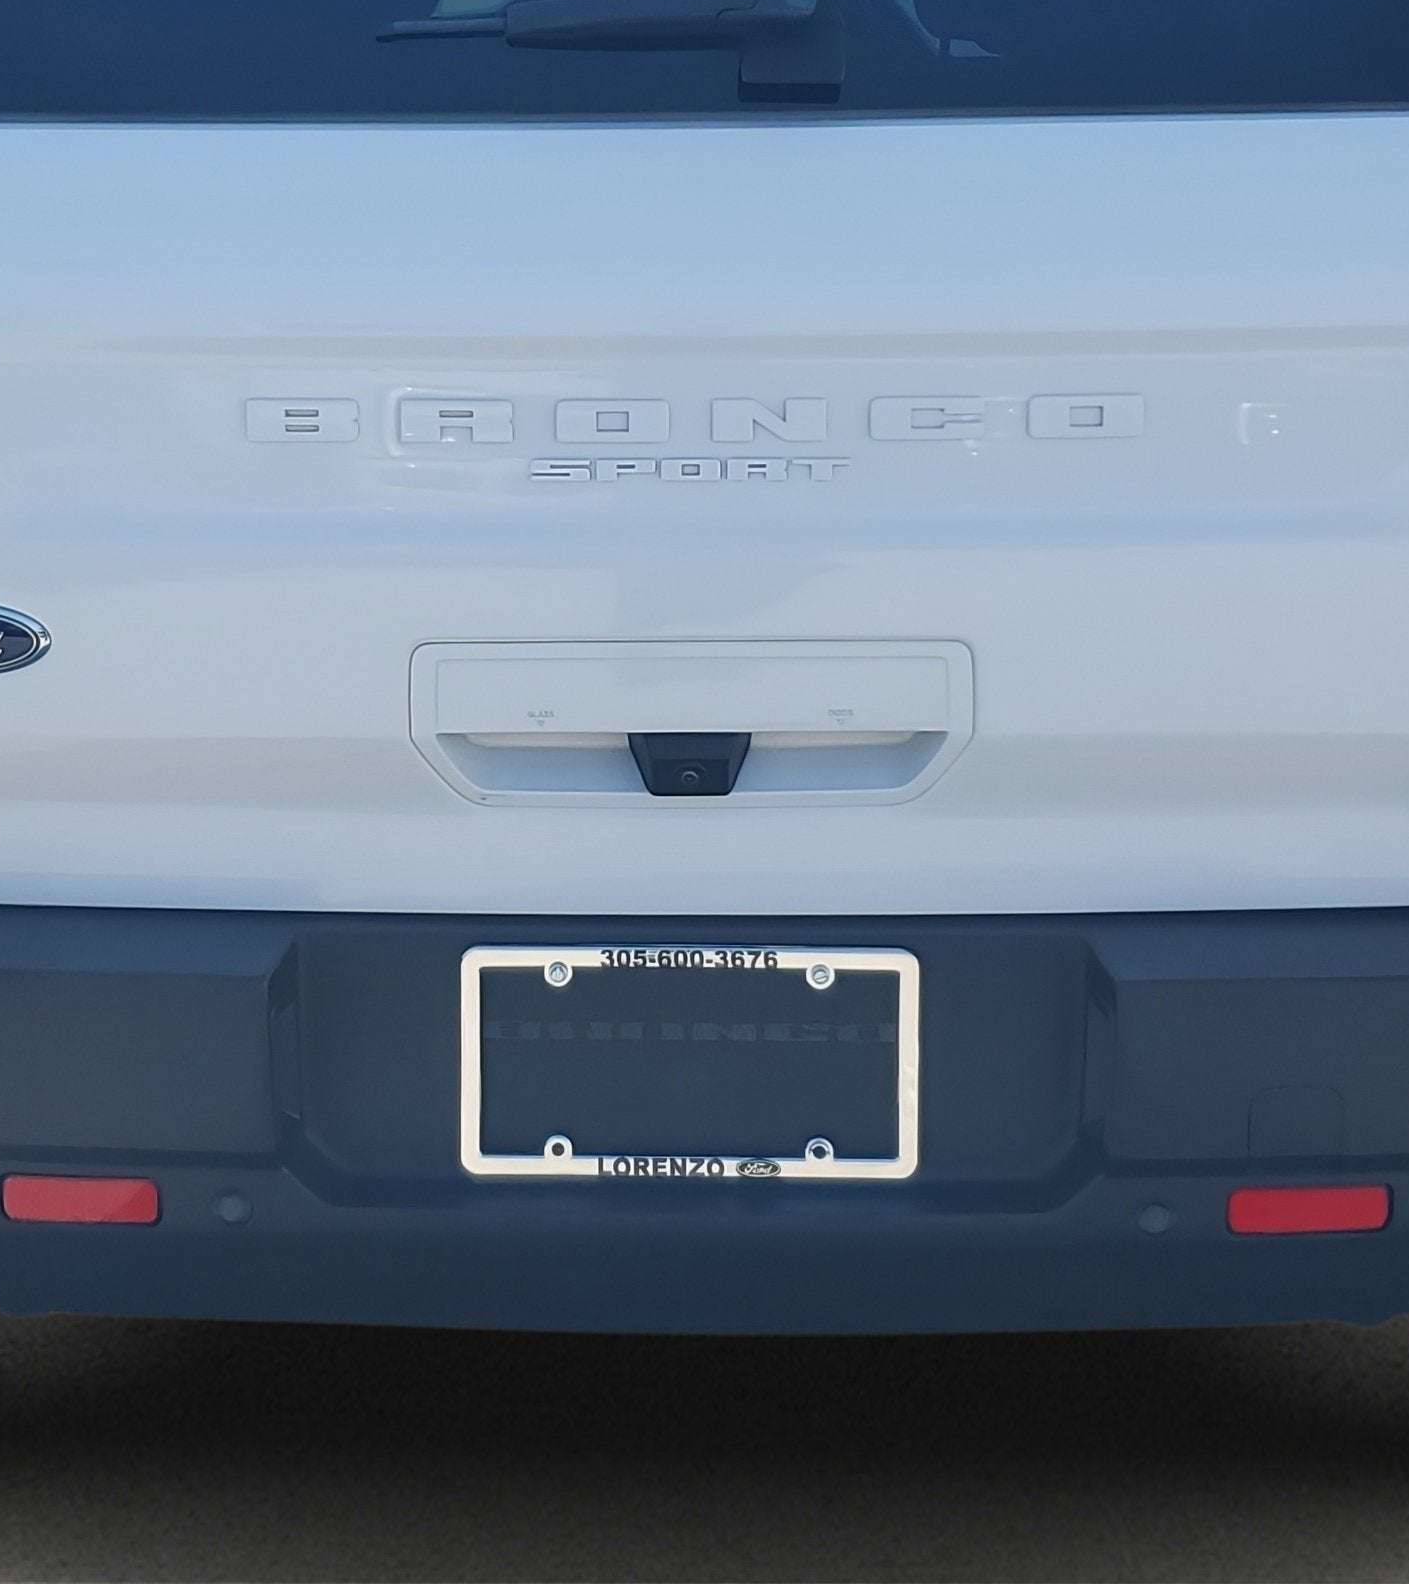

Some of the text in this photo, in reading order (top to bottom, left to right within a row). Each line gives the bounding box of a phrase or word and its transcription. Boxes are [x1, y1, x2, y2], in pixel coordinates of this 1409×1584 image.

[245, 392, 1145, 444] BRONCO
[530, 456, 852, 482] SPORT
[600, 948, 779, 970] 305-600-3676
[597, 1155, 726, 1178] LORENZO
